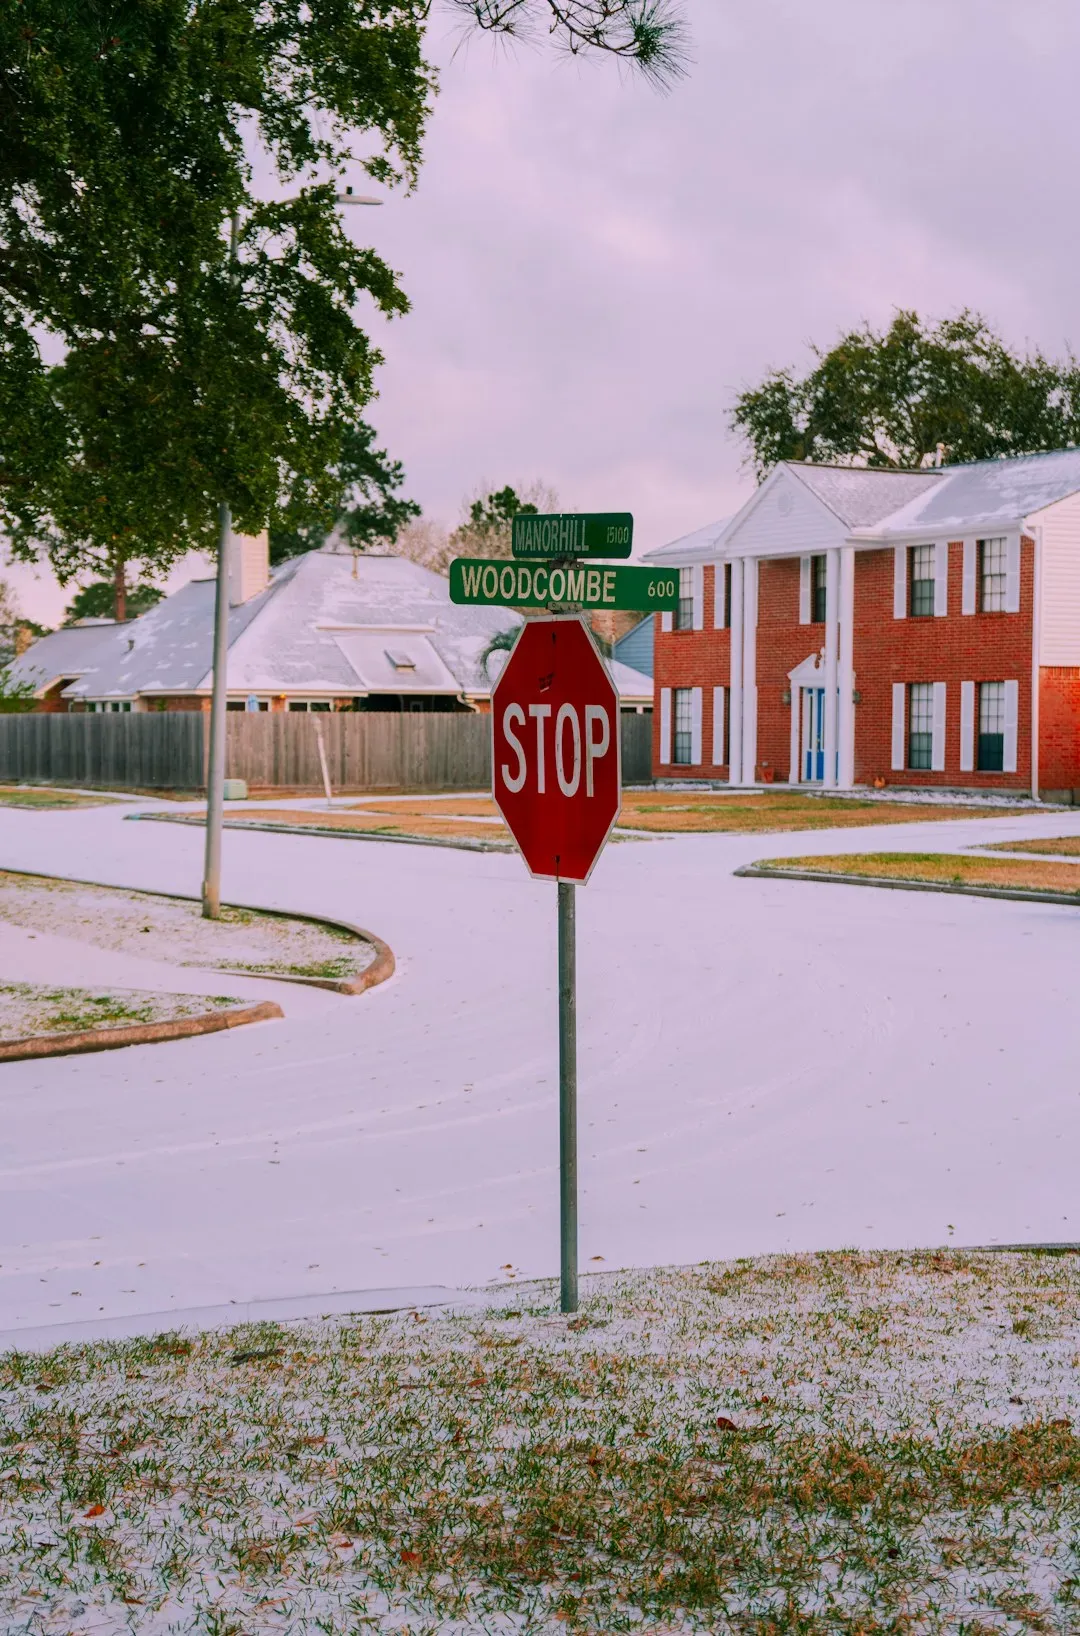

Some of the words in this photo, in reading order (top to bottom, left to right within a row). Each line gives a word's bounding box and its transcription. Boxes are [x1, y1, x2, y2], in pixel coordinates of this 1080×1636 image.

[515, 519, 590, 552] MANORHILL
[606, 526, 629, 544] 15100
[461, 564, 617, 603] WOODCOMBE
[647, 580, 675, 598] 600
[501, 702, 610, 798] STOP
